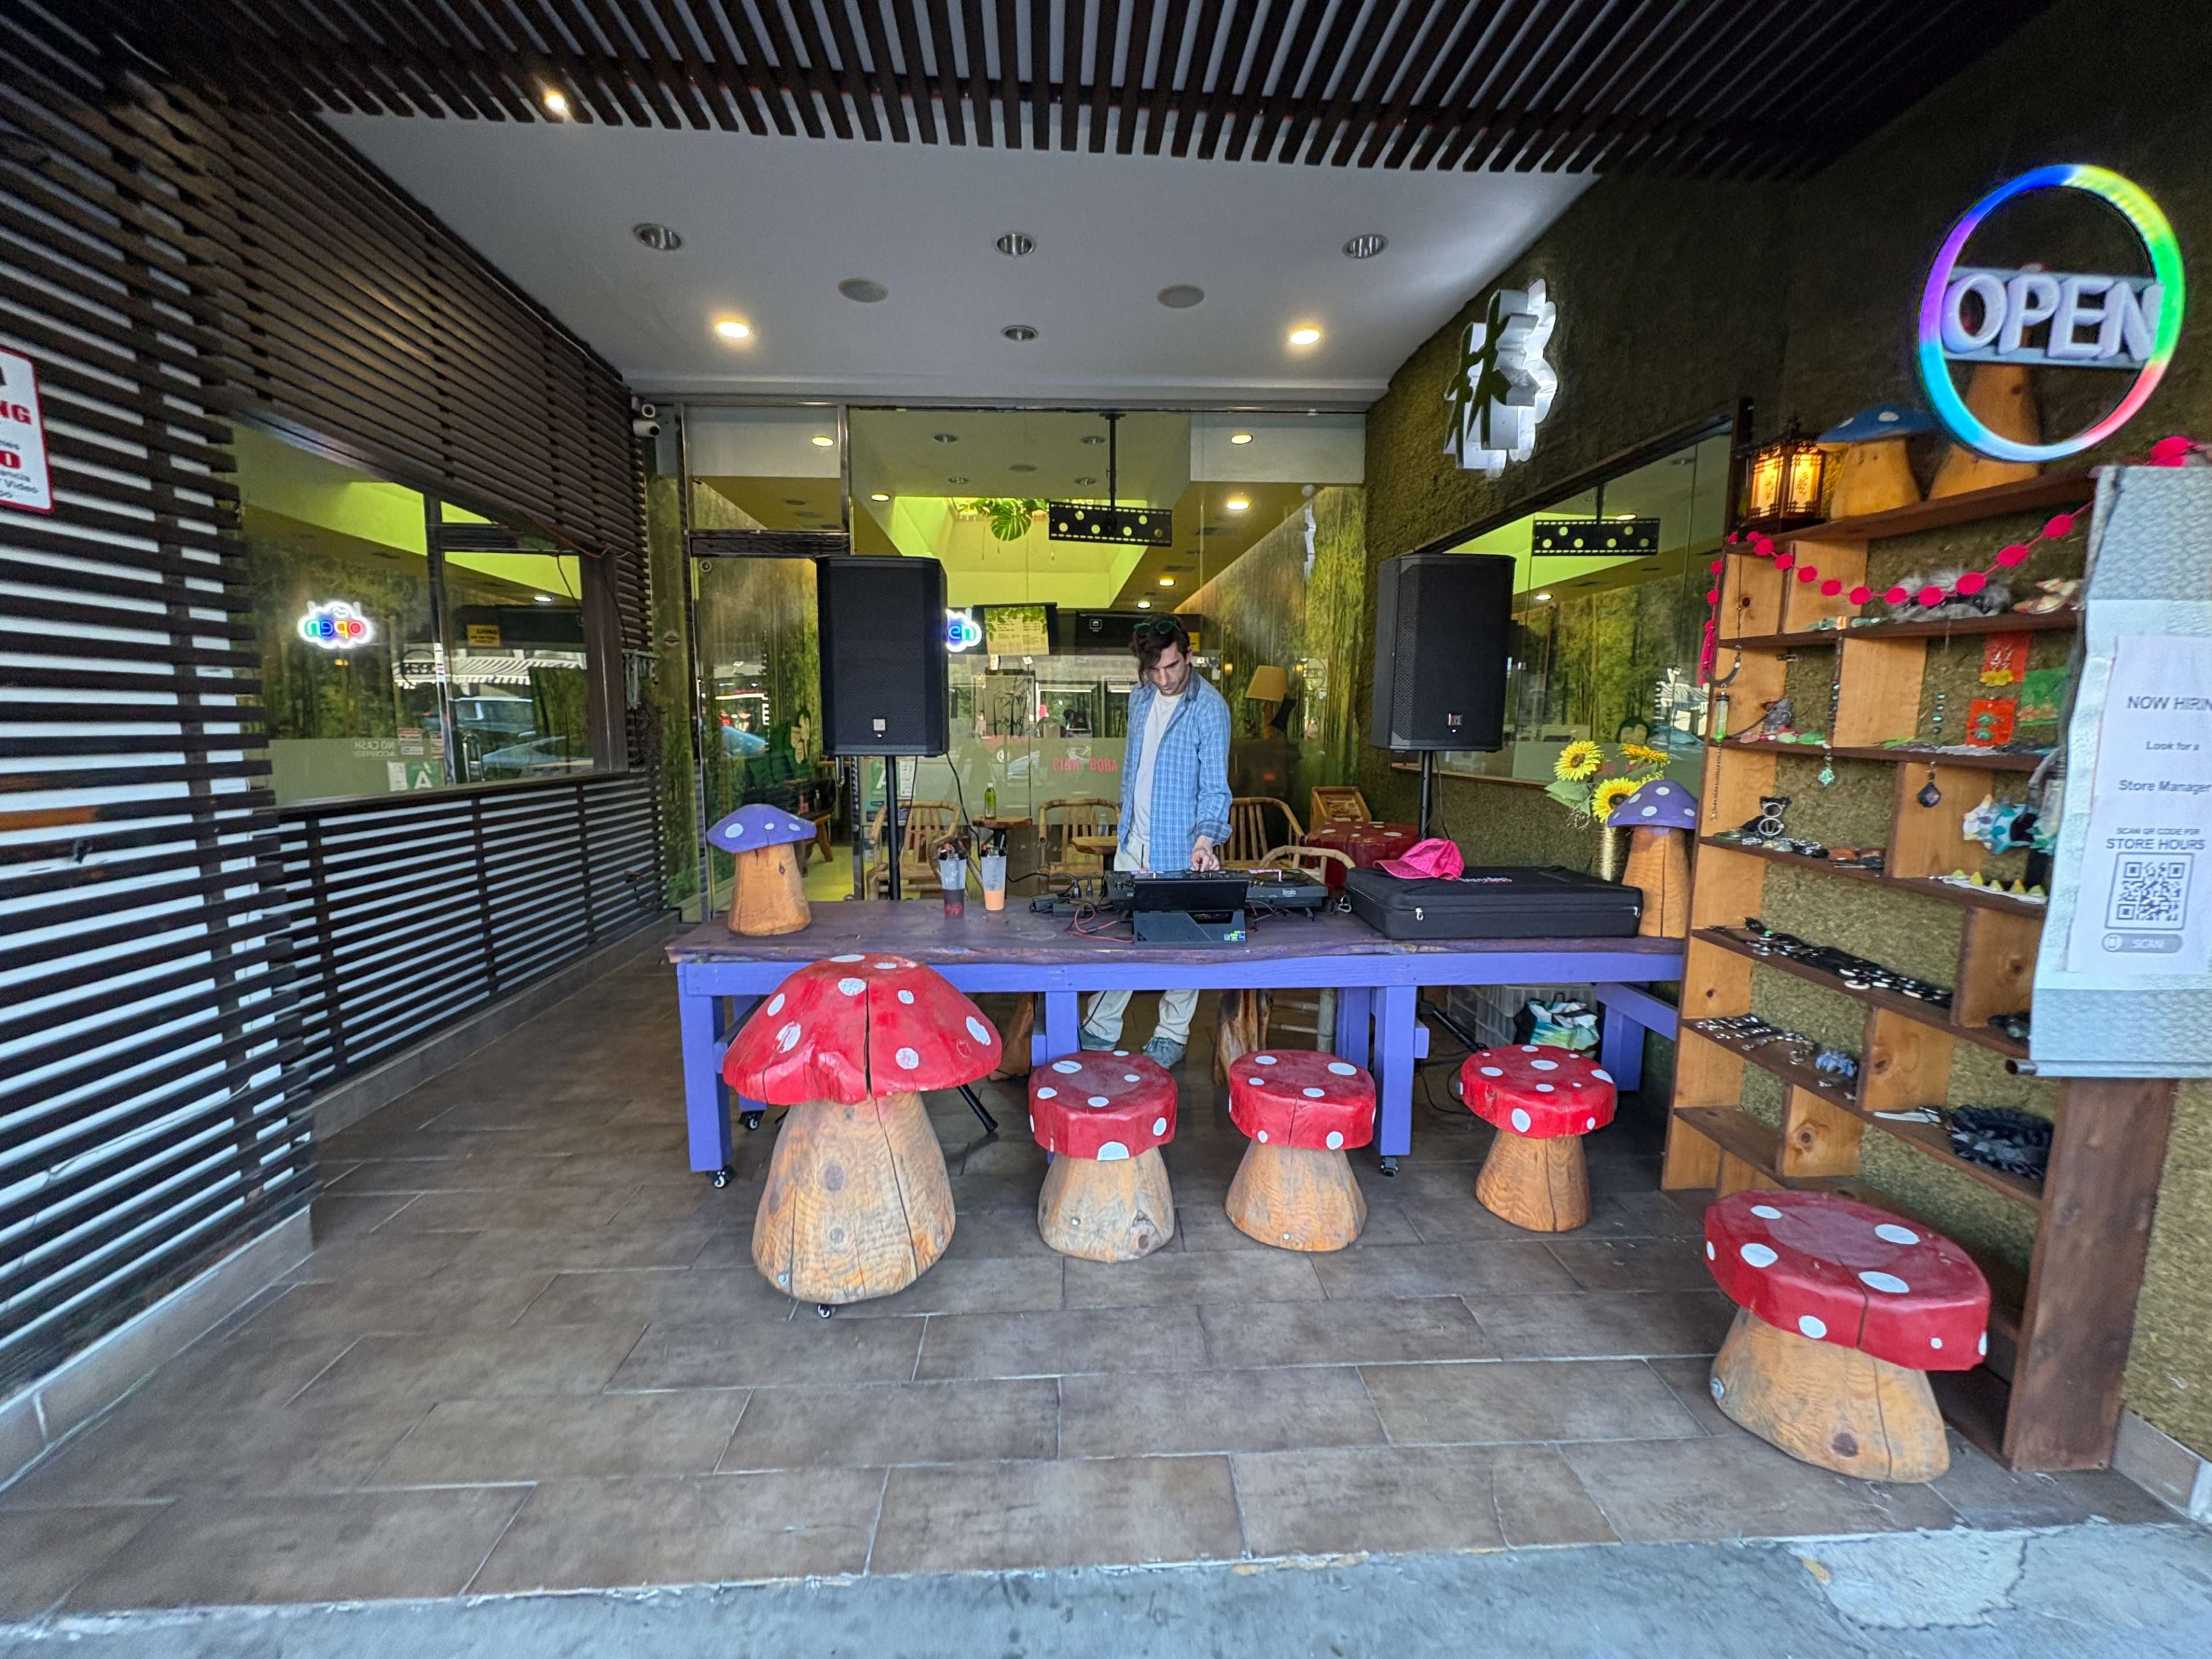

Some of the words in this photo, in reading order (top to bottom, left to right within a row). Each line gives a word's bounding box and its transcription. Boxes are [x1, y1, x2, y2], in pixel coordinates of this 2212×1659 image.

[1941, 273, 2164, 361] OPEN
[949, 625, 976, 641] en
[2127, 695, 2170, 710] NOW
[2146, 741, 2174, 750] Look
[2176, 741, 2192, 751] for
[2118, 779, 2156, 791] Store
[2105, 838, 2154, 850] STORE
[2158, 839, 2206, 850] HOURS
[2131, 938, 2165, 949] SCAN
